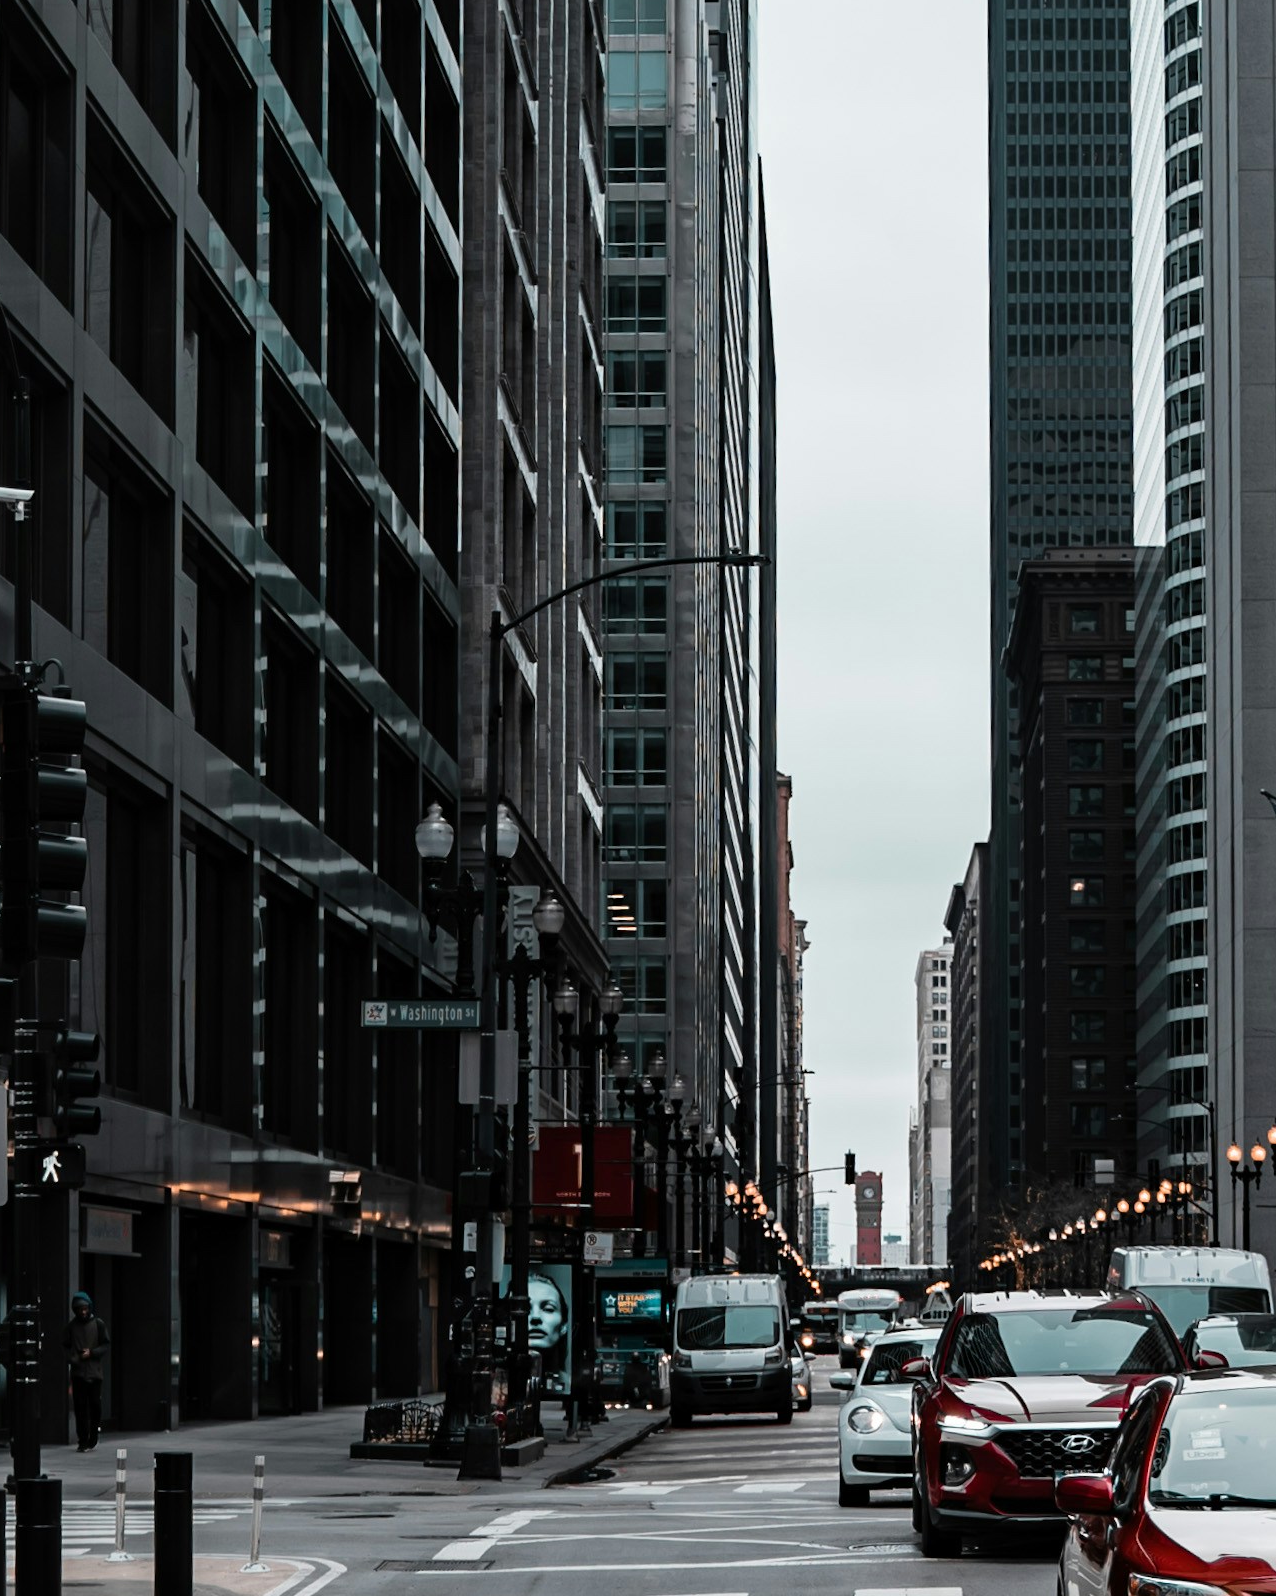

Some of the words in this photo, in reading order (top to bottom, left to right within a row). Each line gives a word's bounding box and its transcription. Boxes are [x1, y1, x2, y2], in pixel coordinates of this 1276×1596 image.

[390, 1007, 397, 1017] W
[399, 1004, 463, 1025] Washington
[465, 1007, 475, 1018] St
